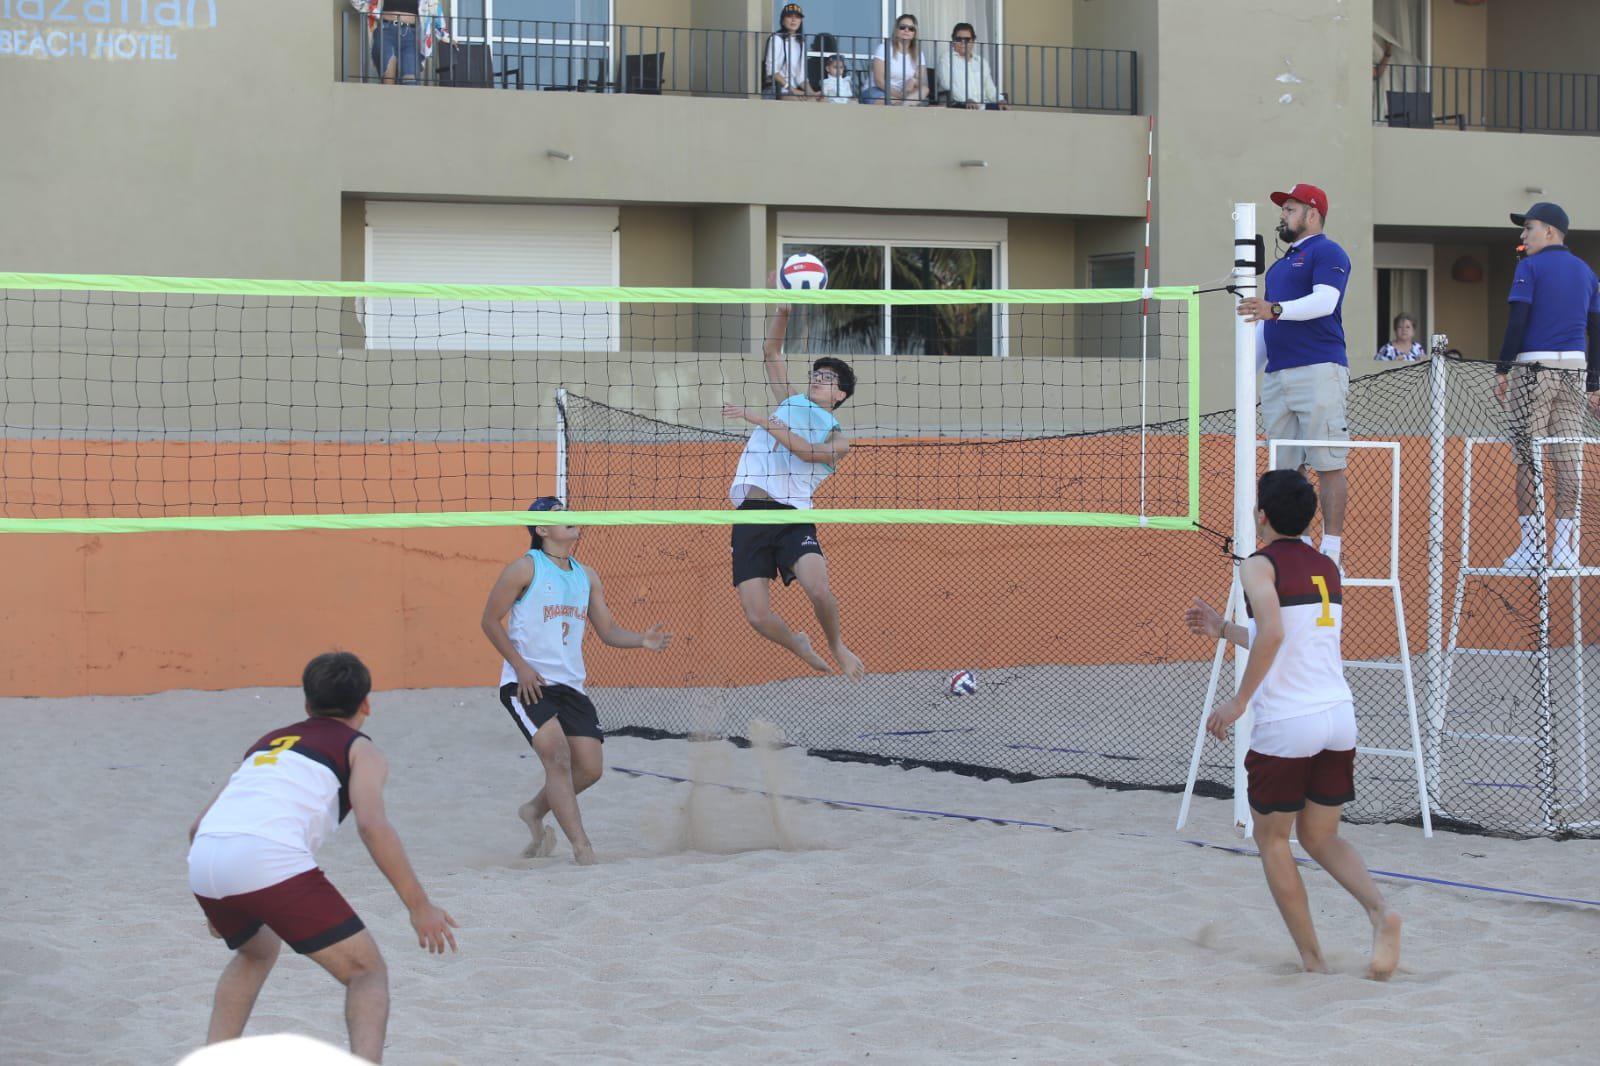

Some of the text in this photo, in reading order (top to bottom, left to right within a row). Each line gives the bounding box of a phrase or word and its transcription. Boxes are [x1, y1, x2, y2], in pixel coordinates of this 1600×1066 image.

[3, 0, 217, 28] azaan
[0, 29, 177, 60] BEACH HOTEL
[1310, 575, 1336, 627] 1
[253, 735, 302, 768] 2
